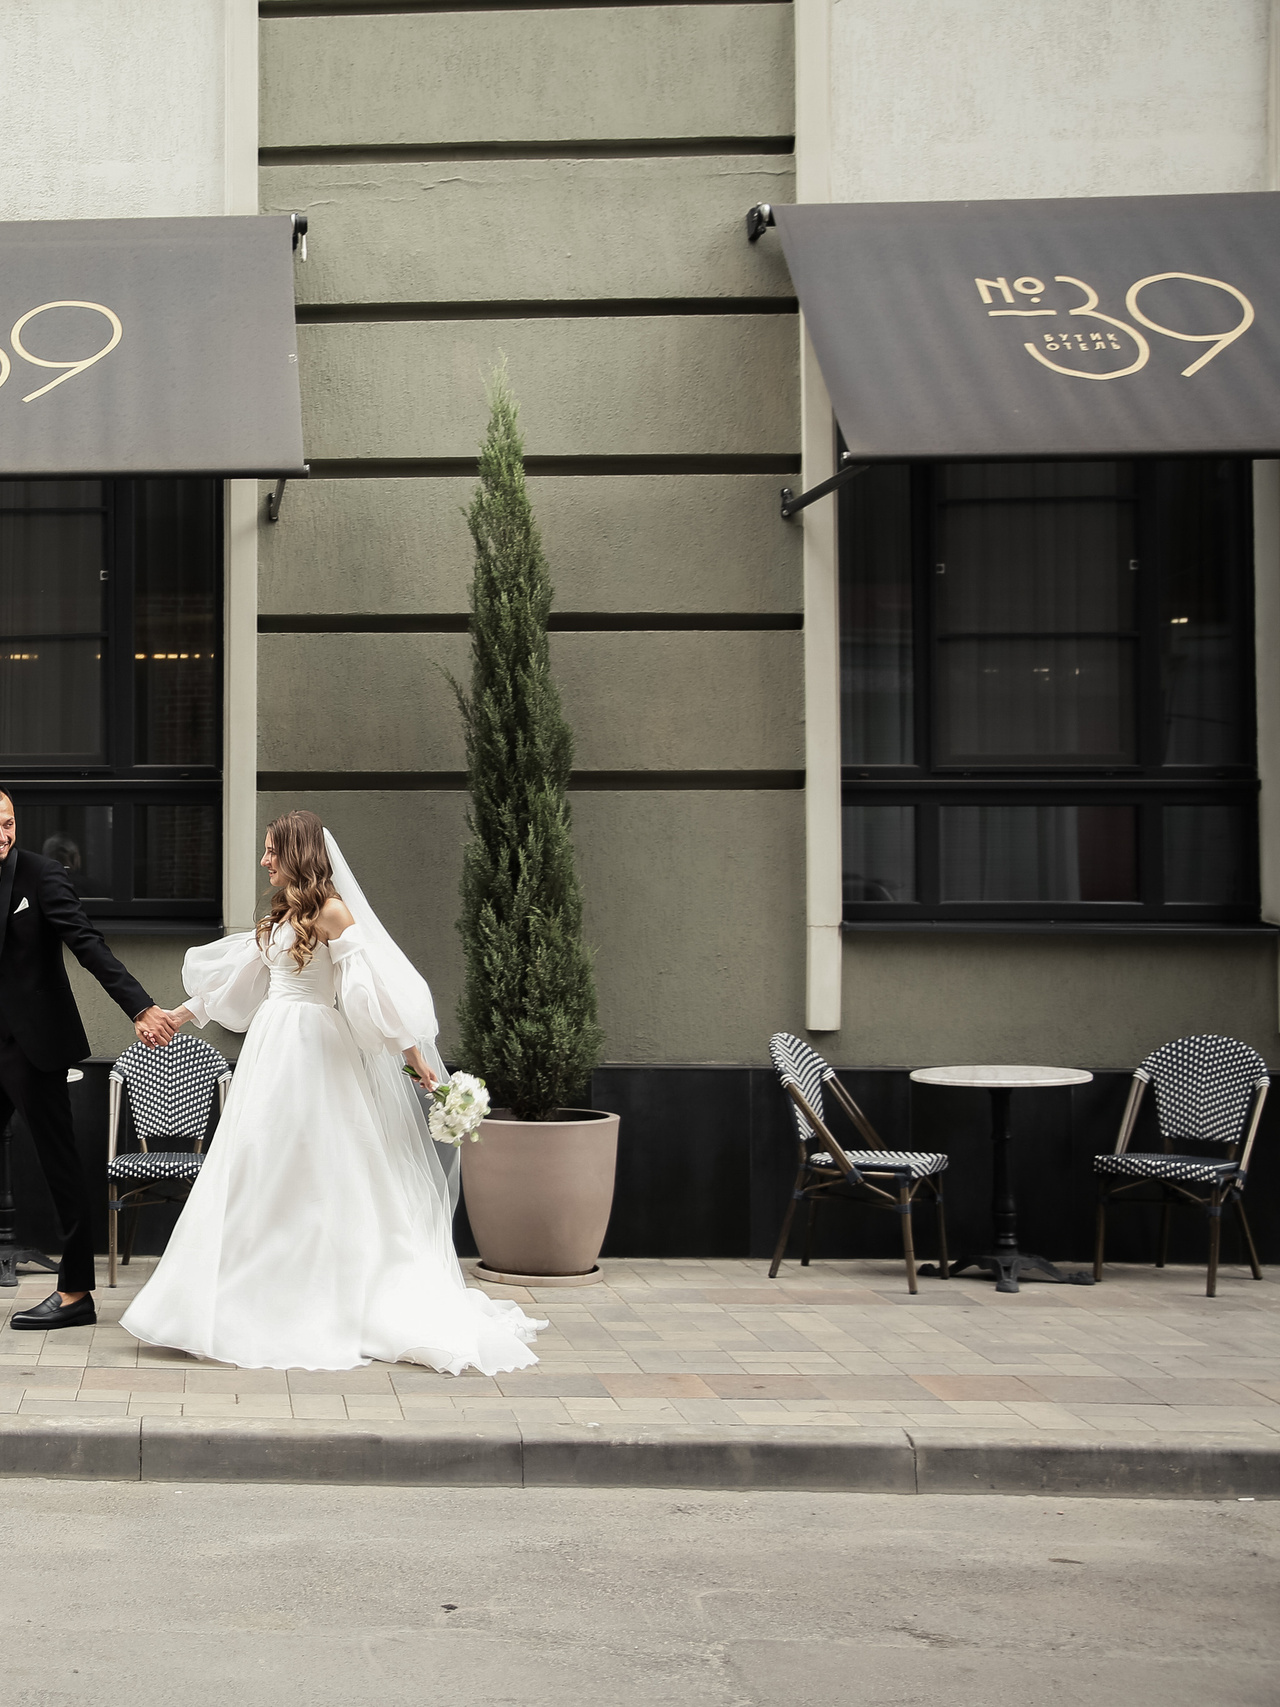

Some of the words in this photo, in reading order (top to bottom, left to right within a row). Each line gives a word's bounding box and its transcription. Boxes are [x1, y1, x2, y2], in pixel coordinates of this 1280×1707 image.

[1023, 271, 1255, 381] 39
[1043, 332, 1118, 343] БУТИК
[1045, 341, 1122, 351] ОТЕЛЬ
